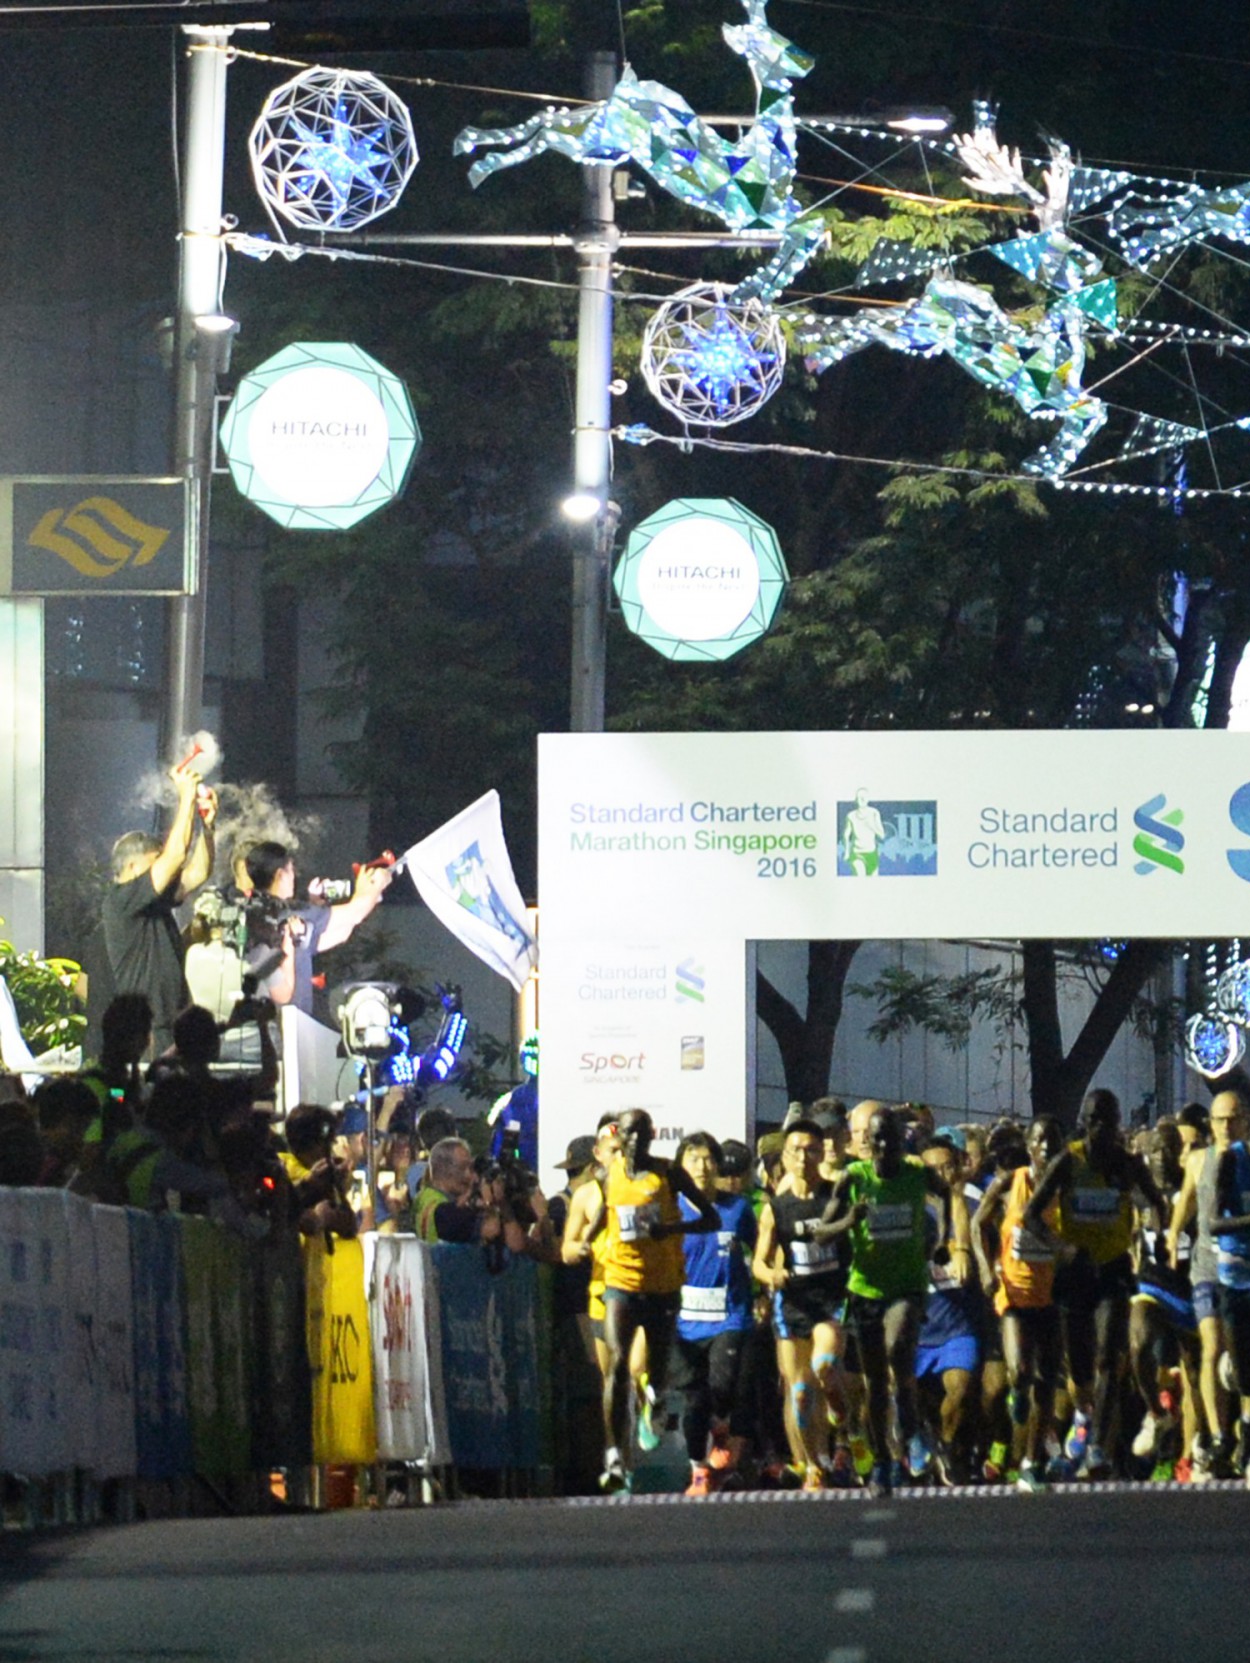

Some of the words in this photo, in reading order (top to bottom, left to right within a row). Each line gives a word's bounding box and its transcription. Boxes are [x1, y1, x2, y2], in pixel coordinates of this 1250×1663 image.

[271, 421, 367, 437] HITACHI
[657, 565, 741, 579] HITACHI
[570, 800, 685, 824] Standard
[690, 800, 818, 823] Chartered
[979, 806, 1118, 834] Standard
[570, 830, 687, 852] Marathon
[694, 829, 818, 856] Singapore
[967, 840, 1118, 869] Chartered
[757, 856, 817, 879] 2016
[585, 962, 668, 981] Standard
[577, 983, 668, 1001] Chartered
[579, 1051, 647, 1074] Sport
